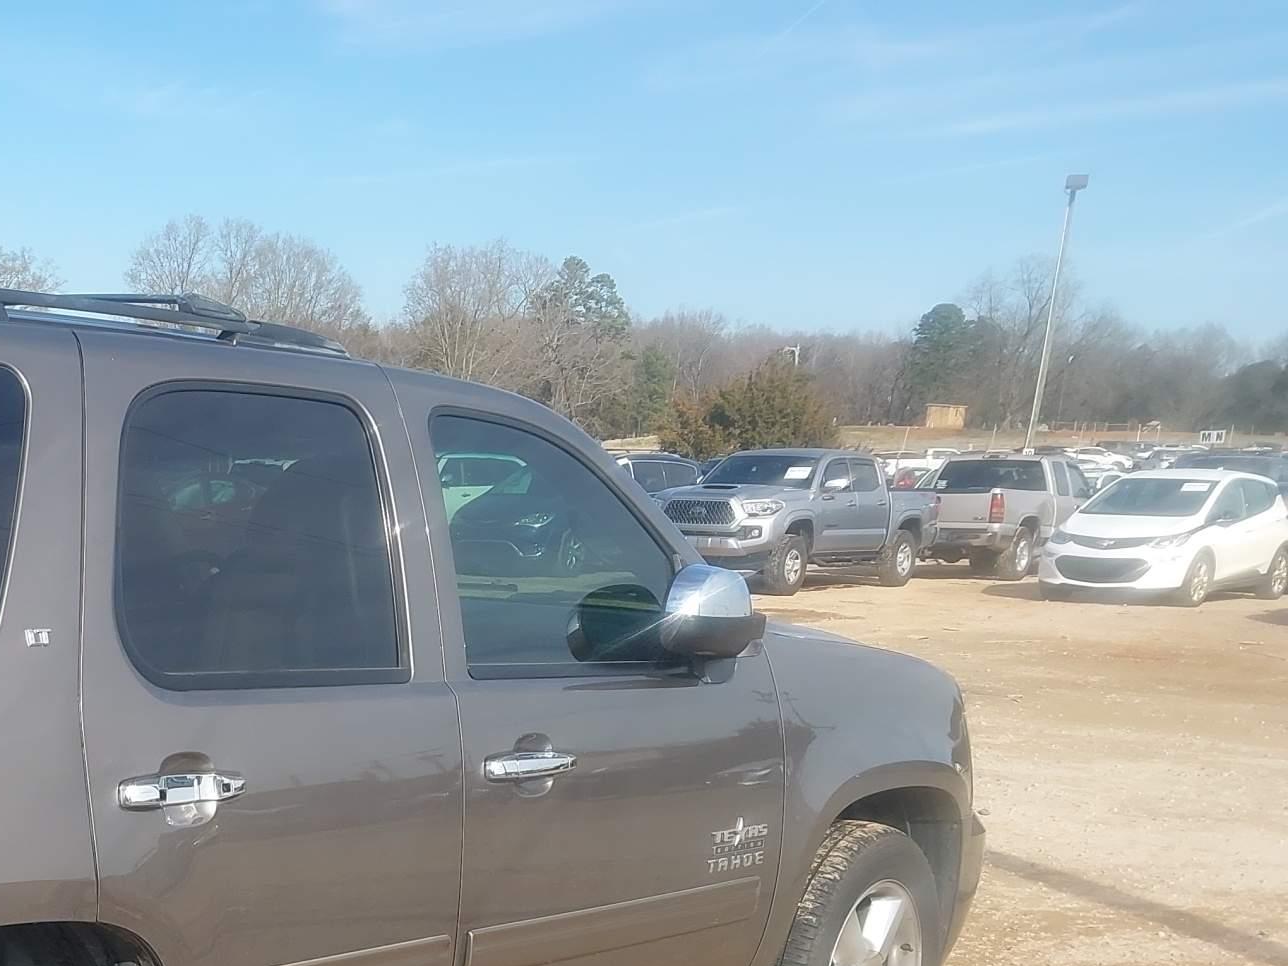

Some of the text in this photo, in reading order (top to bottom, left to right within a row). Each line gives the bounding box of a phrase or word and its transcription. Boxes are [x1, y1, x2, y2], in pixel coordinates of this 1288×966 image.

[1202, 431, 1224, 442] M N
[711, 817, 768, 845] TEXAS
[707, 850, 765, 873] TAHOE
